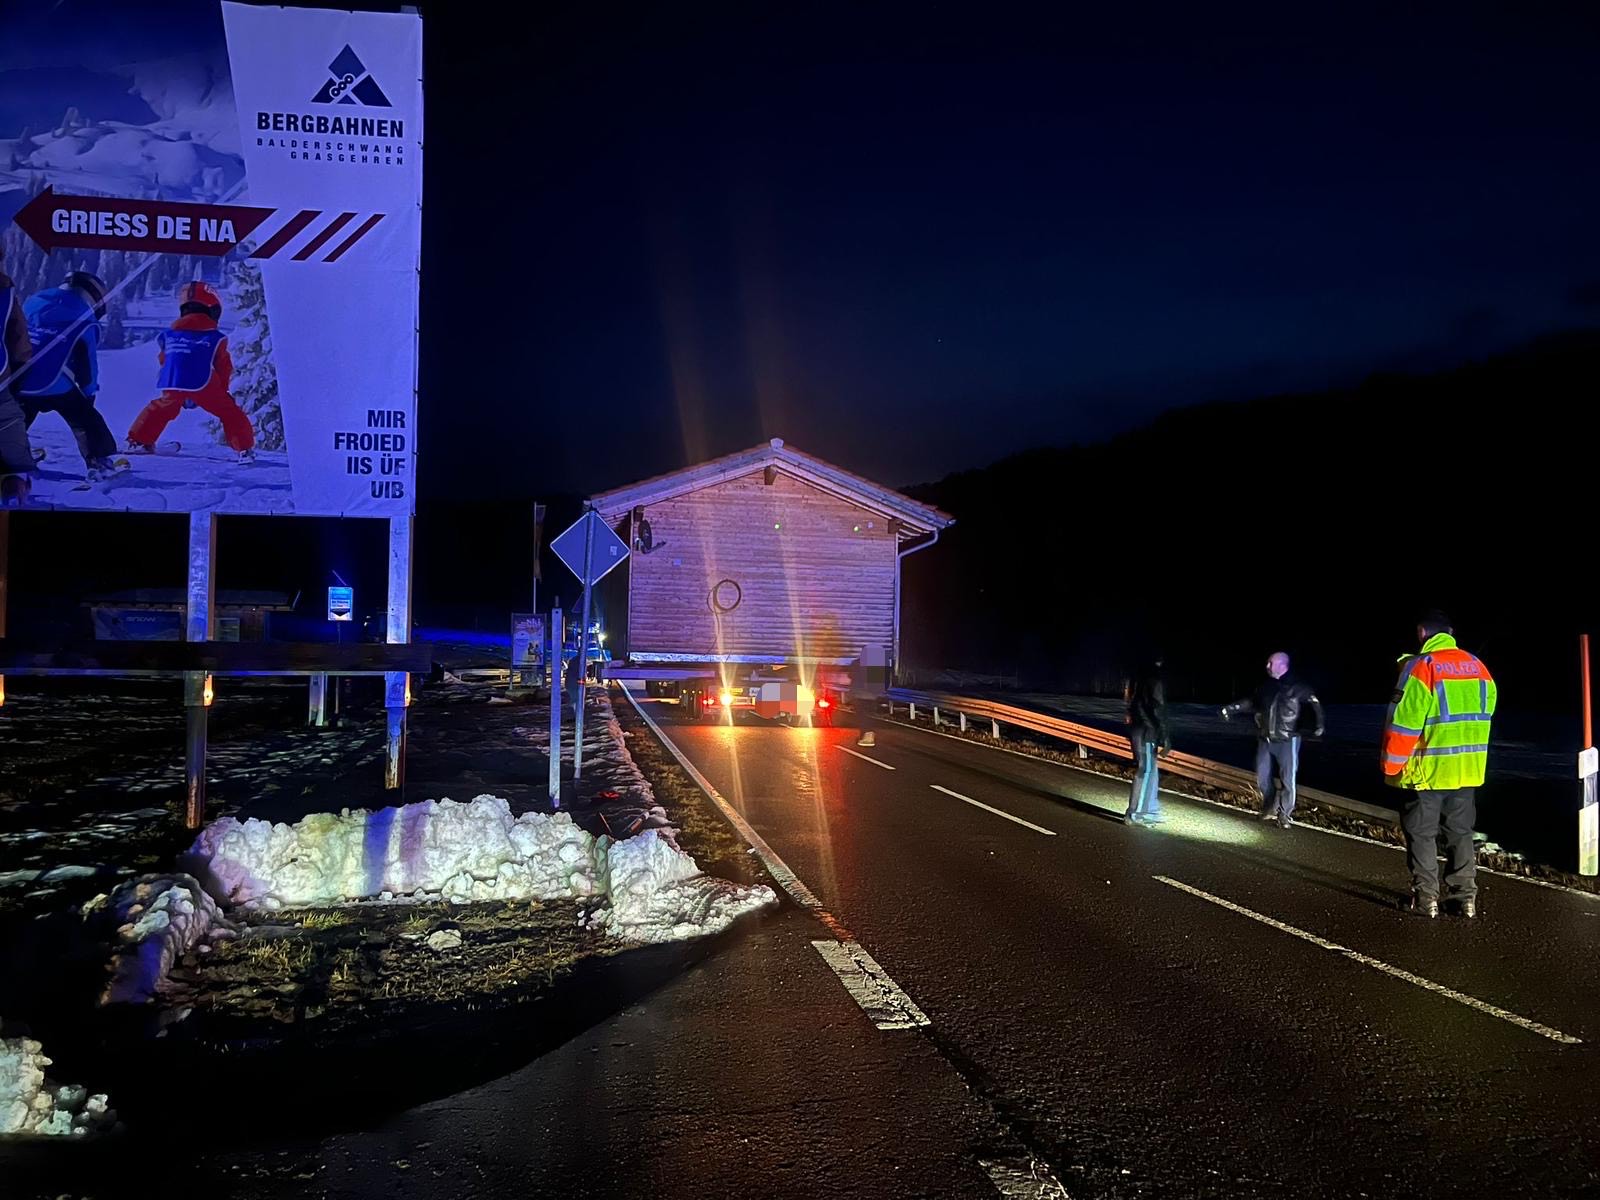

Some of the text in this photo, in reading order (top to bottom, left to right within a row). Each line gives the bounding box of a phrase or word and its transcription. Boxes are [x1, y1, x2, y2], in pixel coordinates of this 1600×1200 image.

[257, 112, 404, 138] BERGBAHNEN
[256, 138, 404, 154] BALDERSCHWANG
[290, 151, 404, 165] GRASGEHREN
[52, 209, 237, 243] GRIESS DE NA
[367, 409, 406, 428] MIR
[334, 432, 406, 452] FROIED
[347, 453, 406, 475] IIS ÜF
[371, 481, 404, 499] UIB
